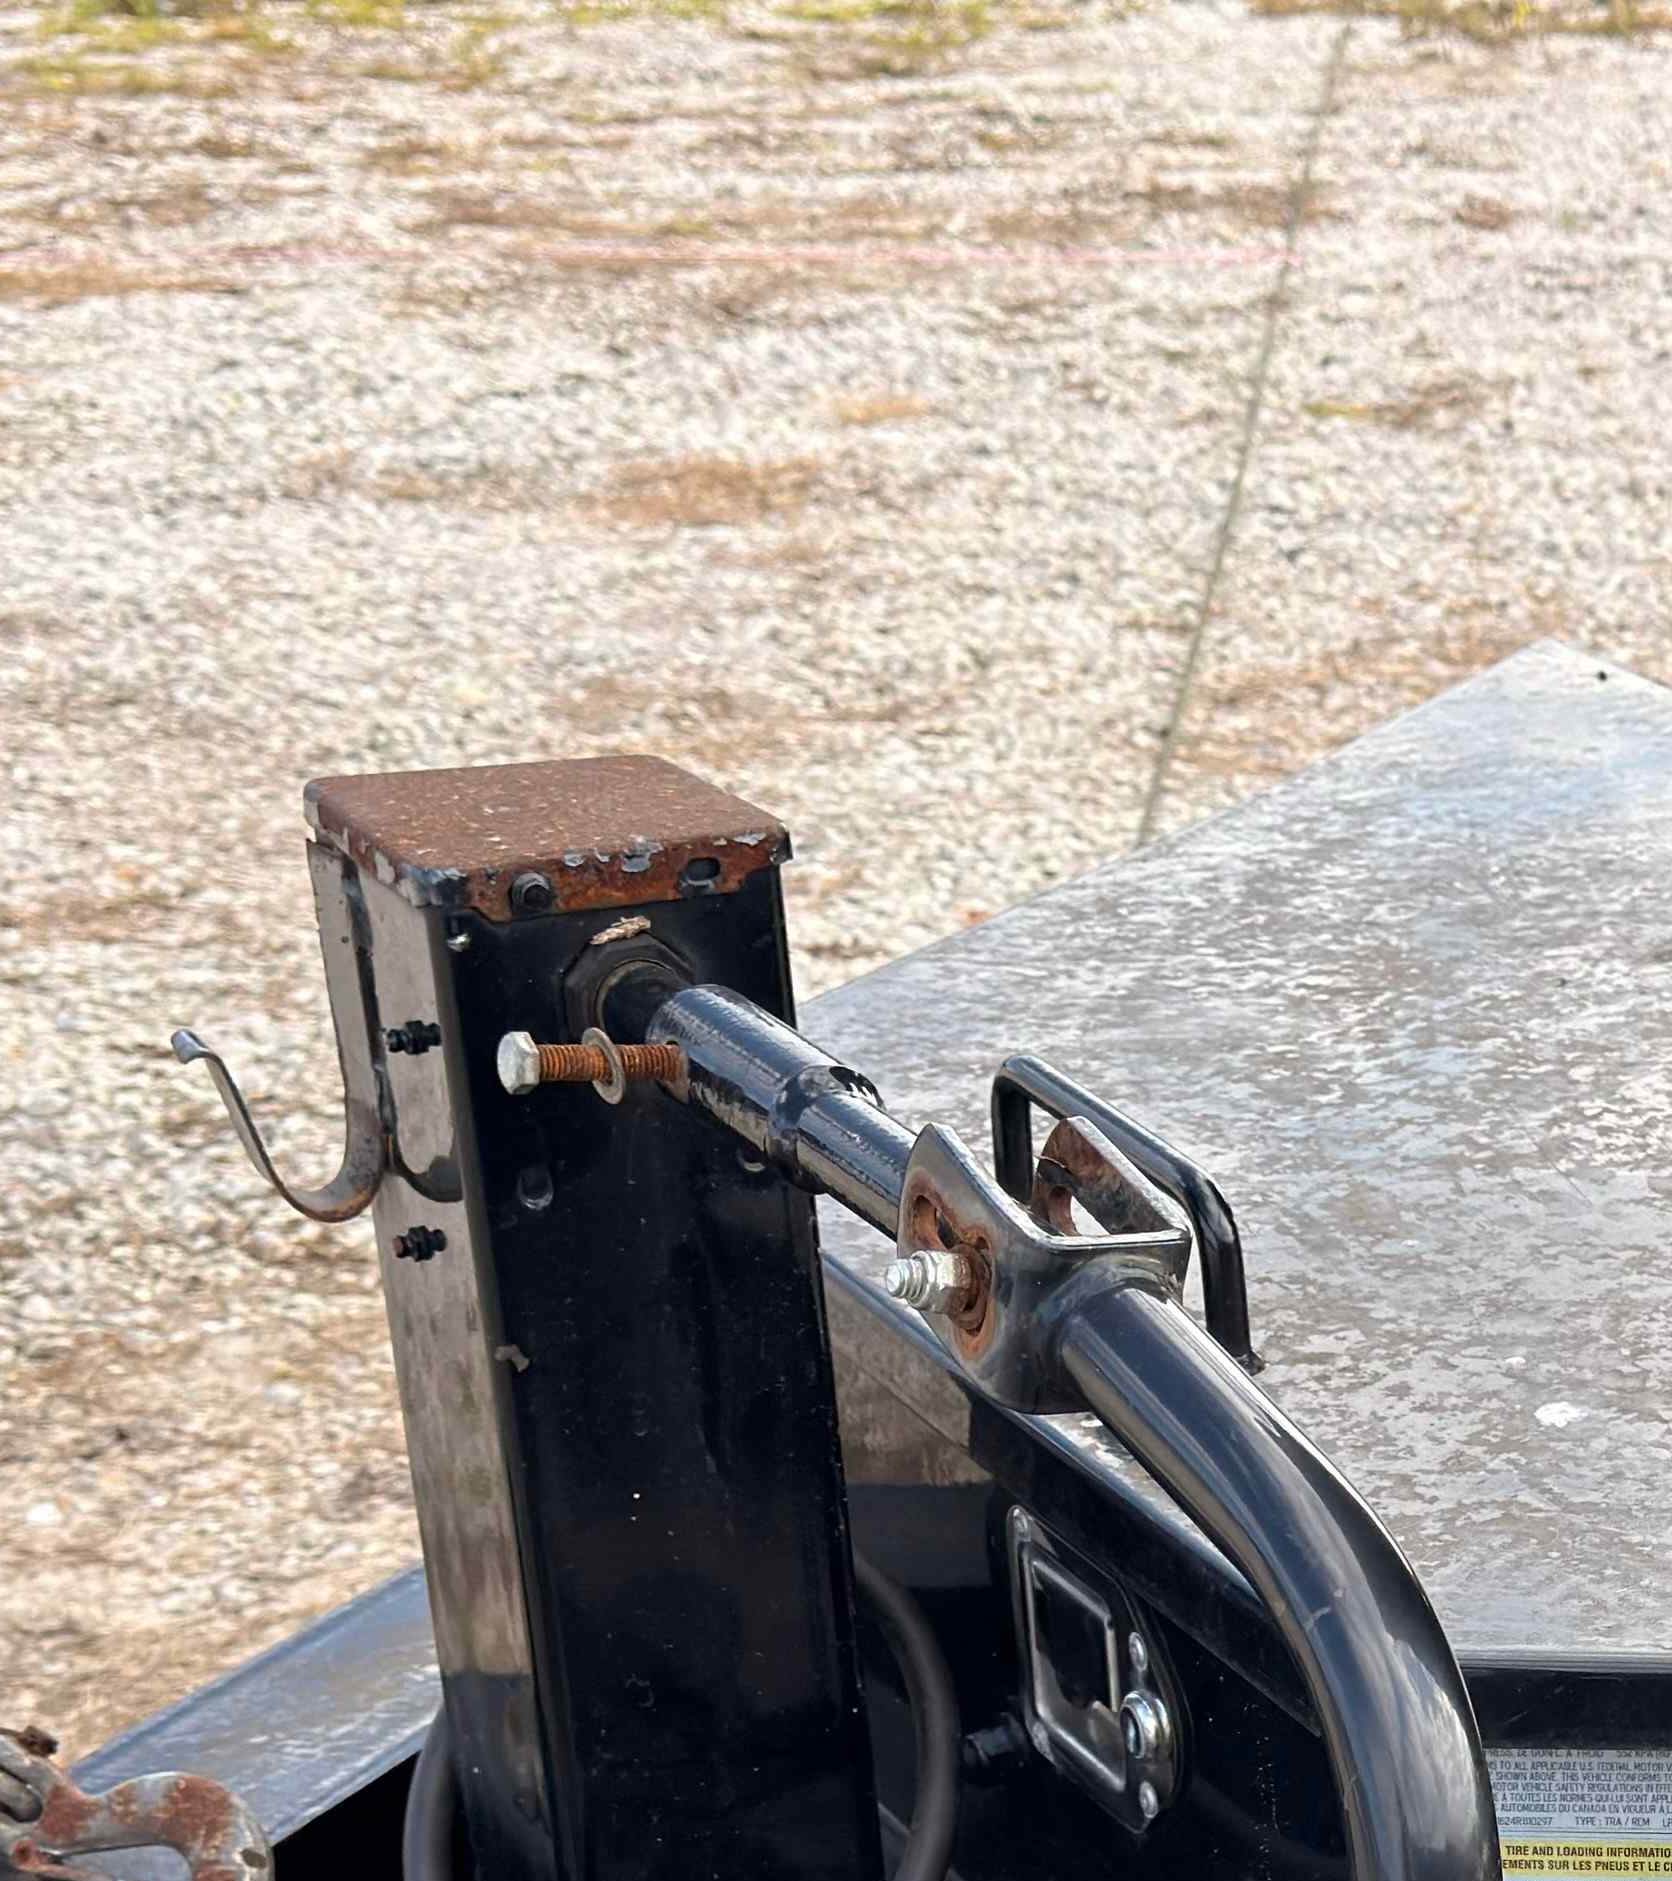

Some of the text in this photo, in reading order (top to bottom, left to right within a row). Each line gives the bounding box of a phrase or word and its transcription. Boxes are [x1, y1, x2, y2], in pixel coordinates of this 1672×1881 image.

[1504, 1845, 1528, 1856] TIRE
[1532, 1846, 1553, 1856] AND
[1557, 1846, 1603, 1857] LOADING
[1502, 1859, 1544, 1870] EMENTS
[1547, 1860, 1569, 1870] SUR
[1573, 1861, 1593, 1871] LES
[1595, 1861, 1629, 1871] PNEUS
[1633, 1861, 1645, 1871] ET
[1648, 1862, 1660, 1872] LE
